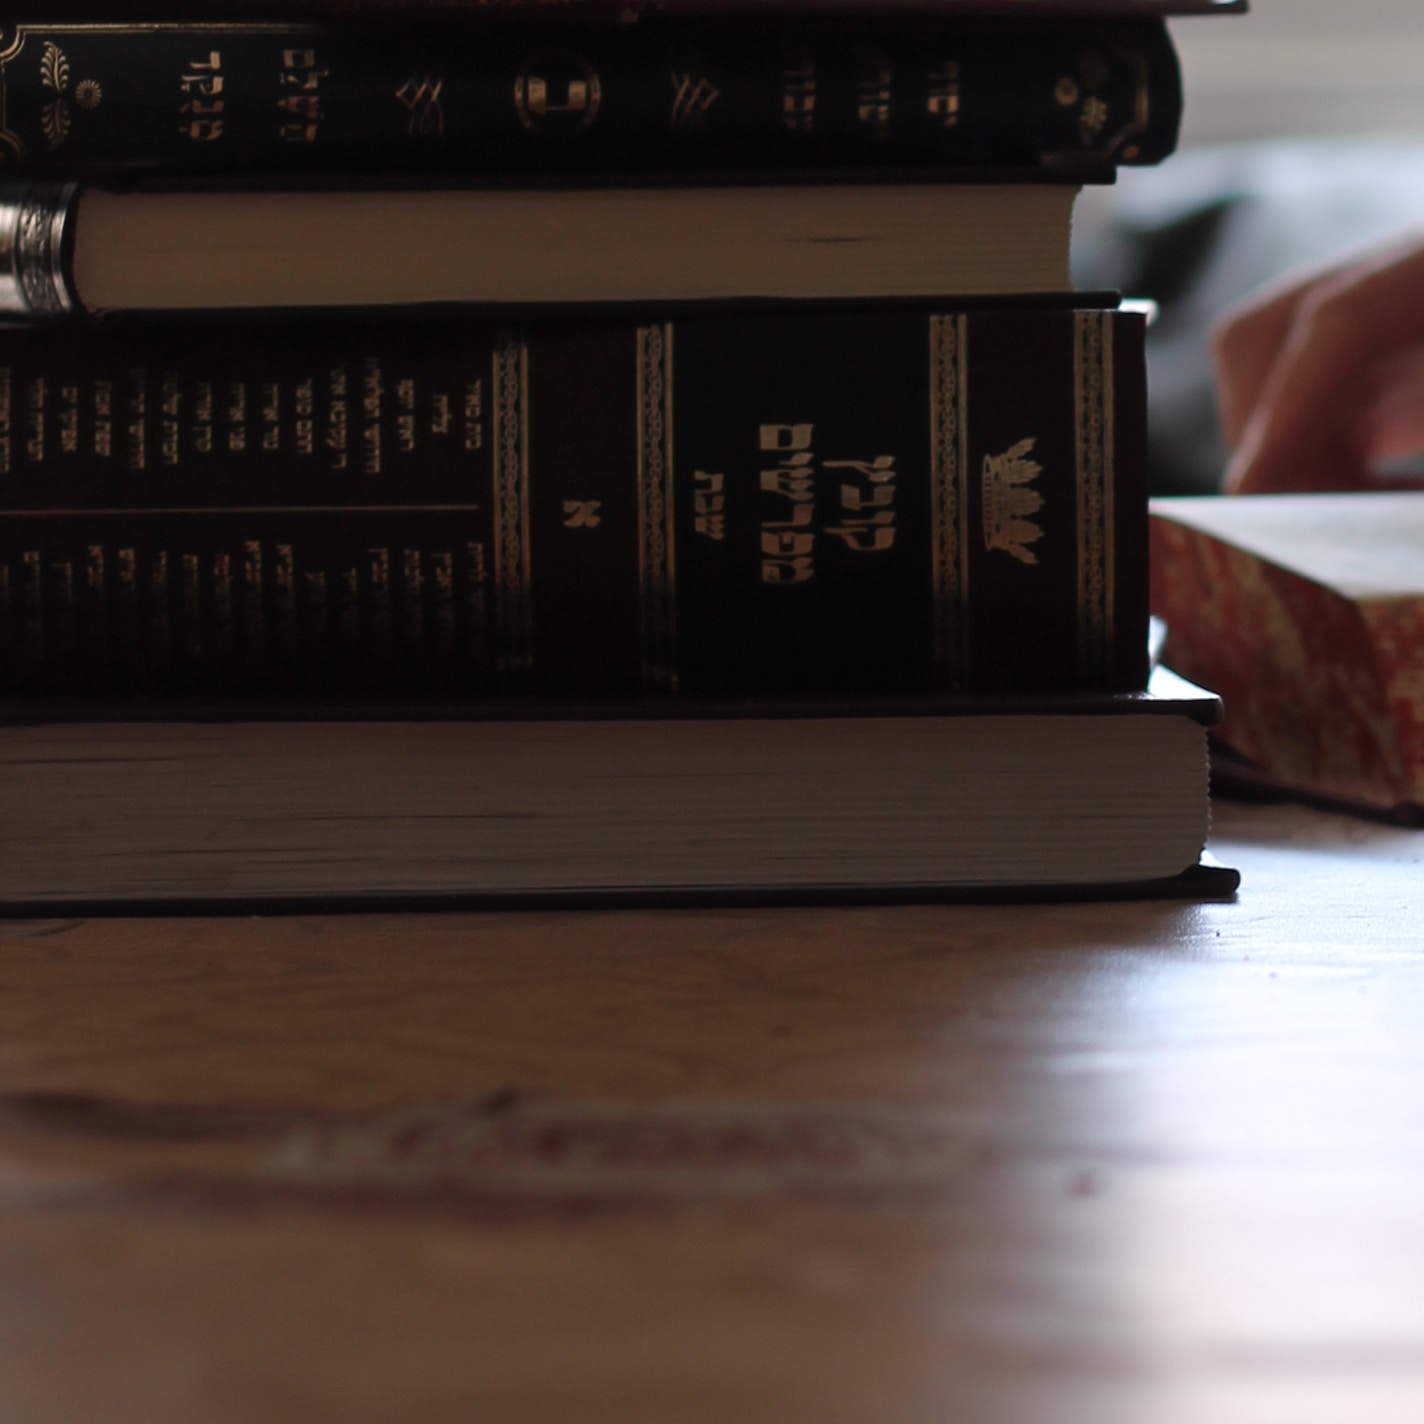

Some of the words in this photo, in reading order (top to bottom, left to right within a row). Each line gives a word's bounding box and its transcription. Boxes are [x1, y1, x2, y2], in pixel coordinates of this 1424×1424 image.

[62, 386, 78, 403] ים
[95, 380, 112, 415] אמת
[296, 378, 312, 414] סופר
[57, 409, 77, 451] אפיקי
[95, 421, 111, 456] שפת
[296, 420, 312, 454] חתם
[326, 401, 346, 448] עקיבא
[398, 415, 414, 452] ראש
[562, 499, 602, 528] א
[693, 470, 726, 541] שבת
[759, 423, 815, 582] מפרשים
[823, 455, 896, 552] קובץ
